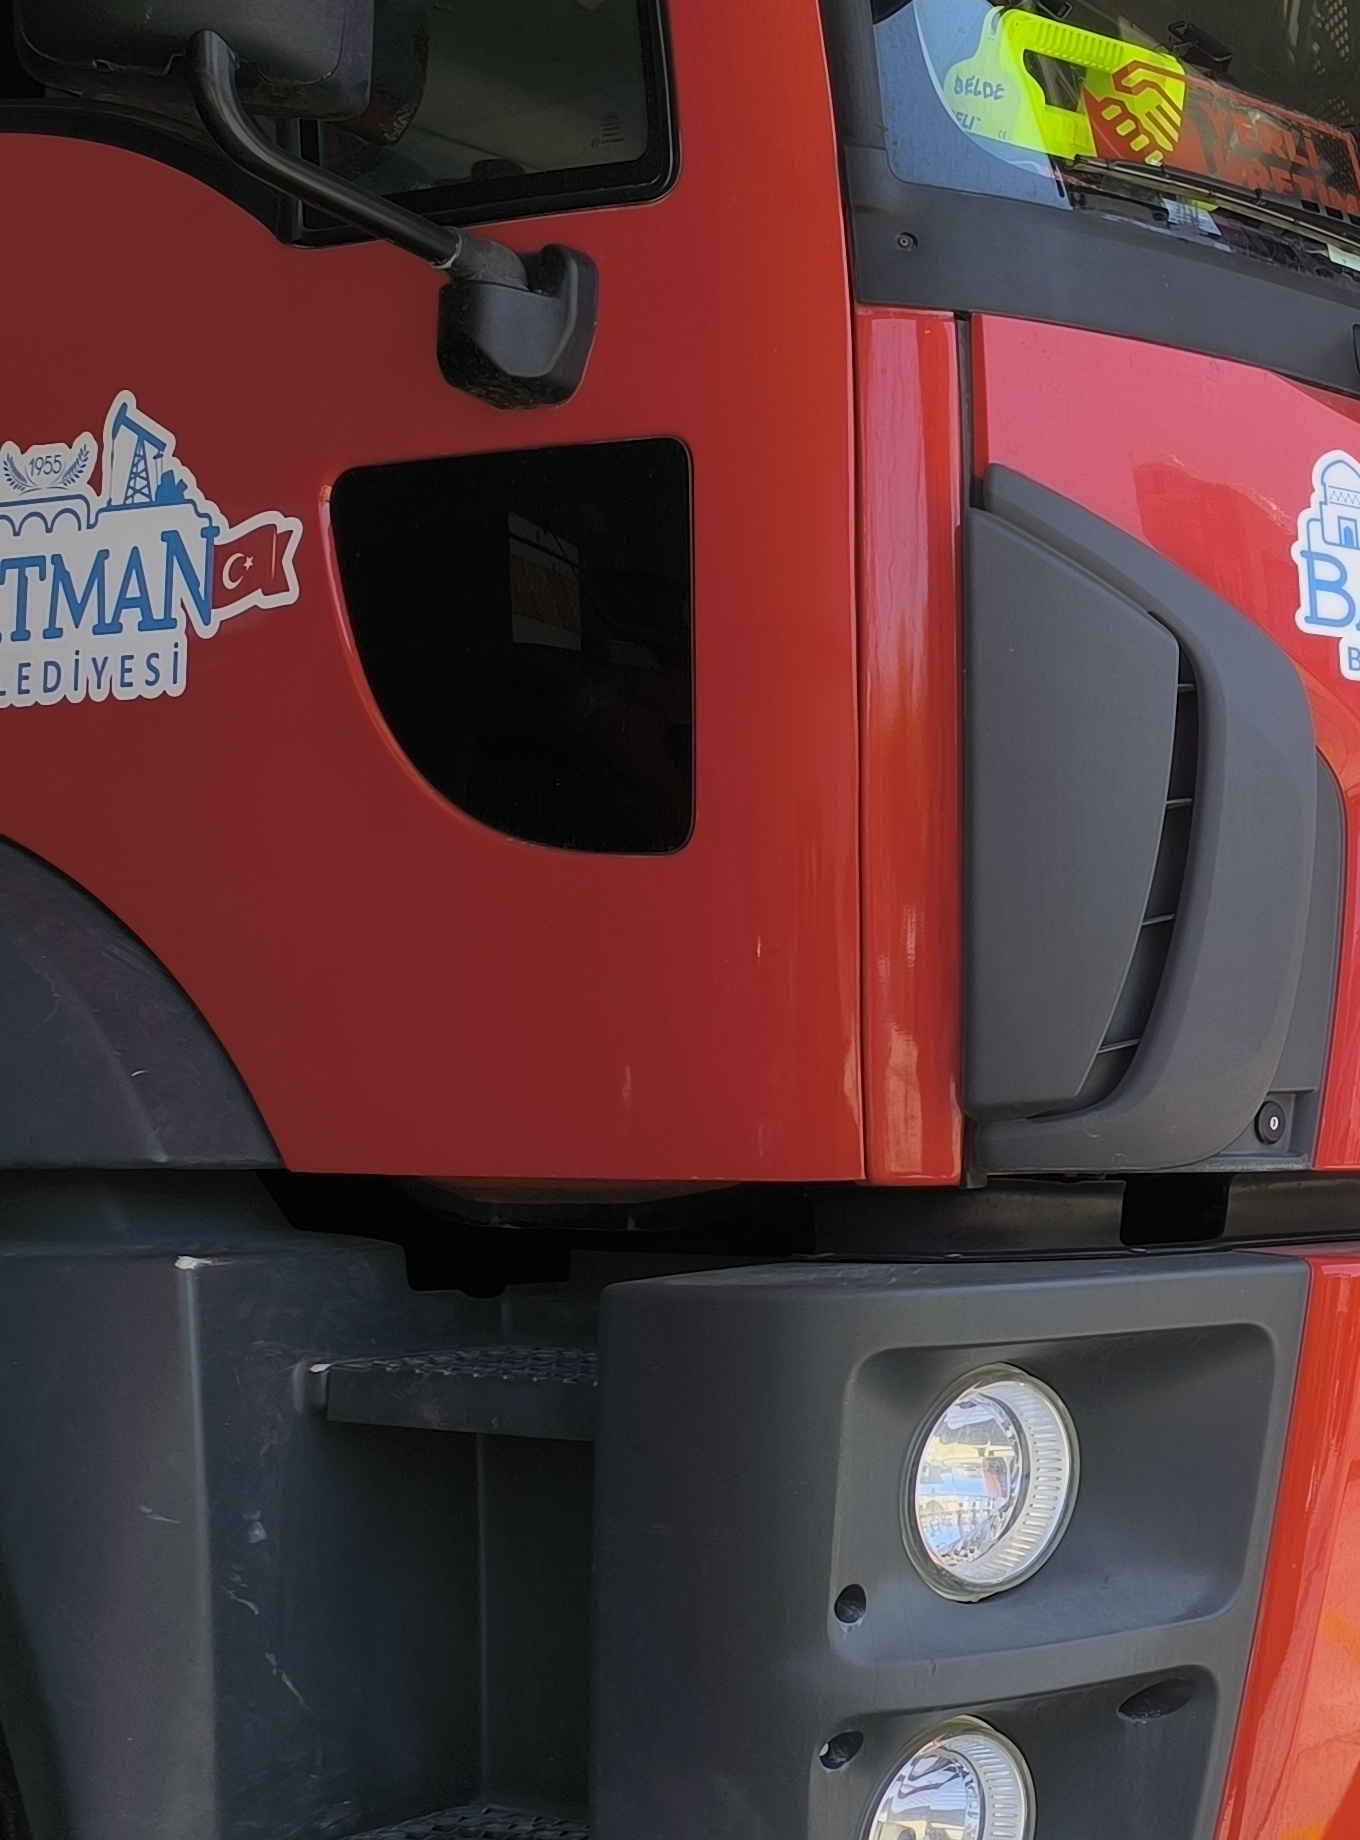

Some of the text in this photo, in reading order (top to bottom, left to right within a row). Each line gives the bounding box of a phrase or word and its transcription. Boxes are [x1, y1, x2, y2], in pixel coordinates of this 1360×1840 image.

[28, 454, 63, 477] 1955
[0, 525, 220, 642] TMAN
[0, 642, 179, 696] EDİYESİ
